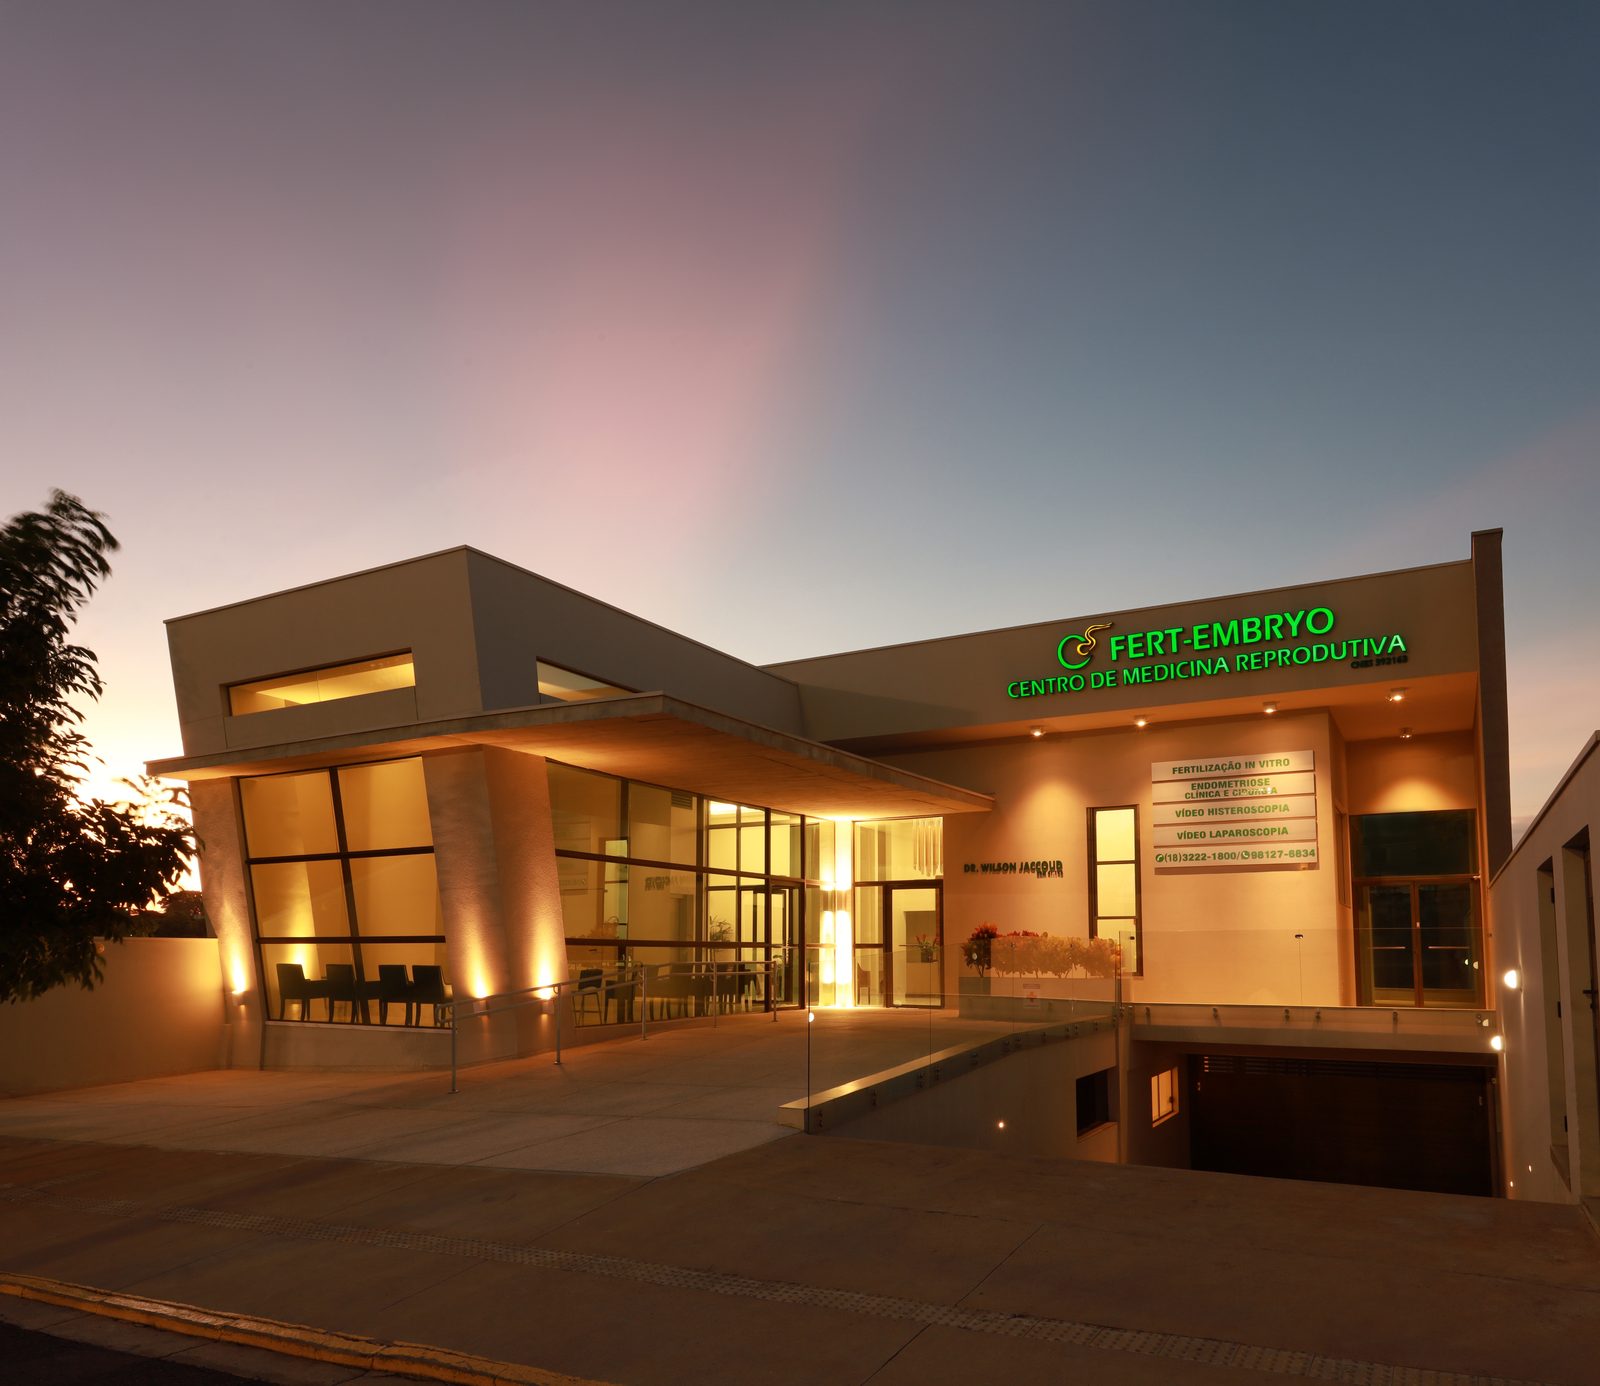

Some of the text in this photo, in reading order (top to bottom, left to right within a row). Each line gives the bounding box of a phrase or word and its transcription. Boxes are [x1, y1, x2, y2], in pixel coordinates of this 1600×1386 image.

[1109, 607, 1335, 661] FERT-EMBRYO
[1007, 634, 1407, 698] CENTRO DE MEDICINA REPRODUTIVA
[1172, 758, 1290, 775] FERTILIZAÇÃO IN VITRO
[1191, 778, 1271, 791] ENDOMETRIOSE
[1184, 788, 1221, 800] CLÍNICA
[1223, 789, 1230, 797] E
[1175, 803, 1290, 818] VÍDEO HISTEROSCOPIA
[1176, 826, 1289, 840] VÍDEO LAPAROSCOPIA
[964, 864, 979, 873] DR.
[981, 863, 1017, 873] WILSON
